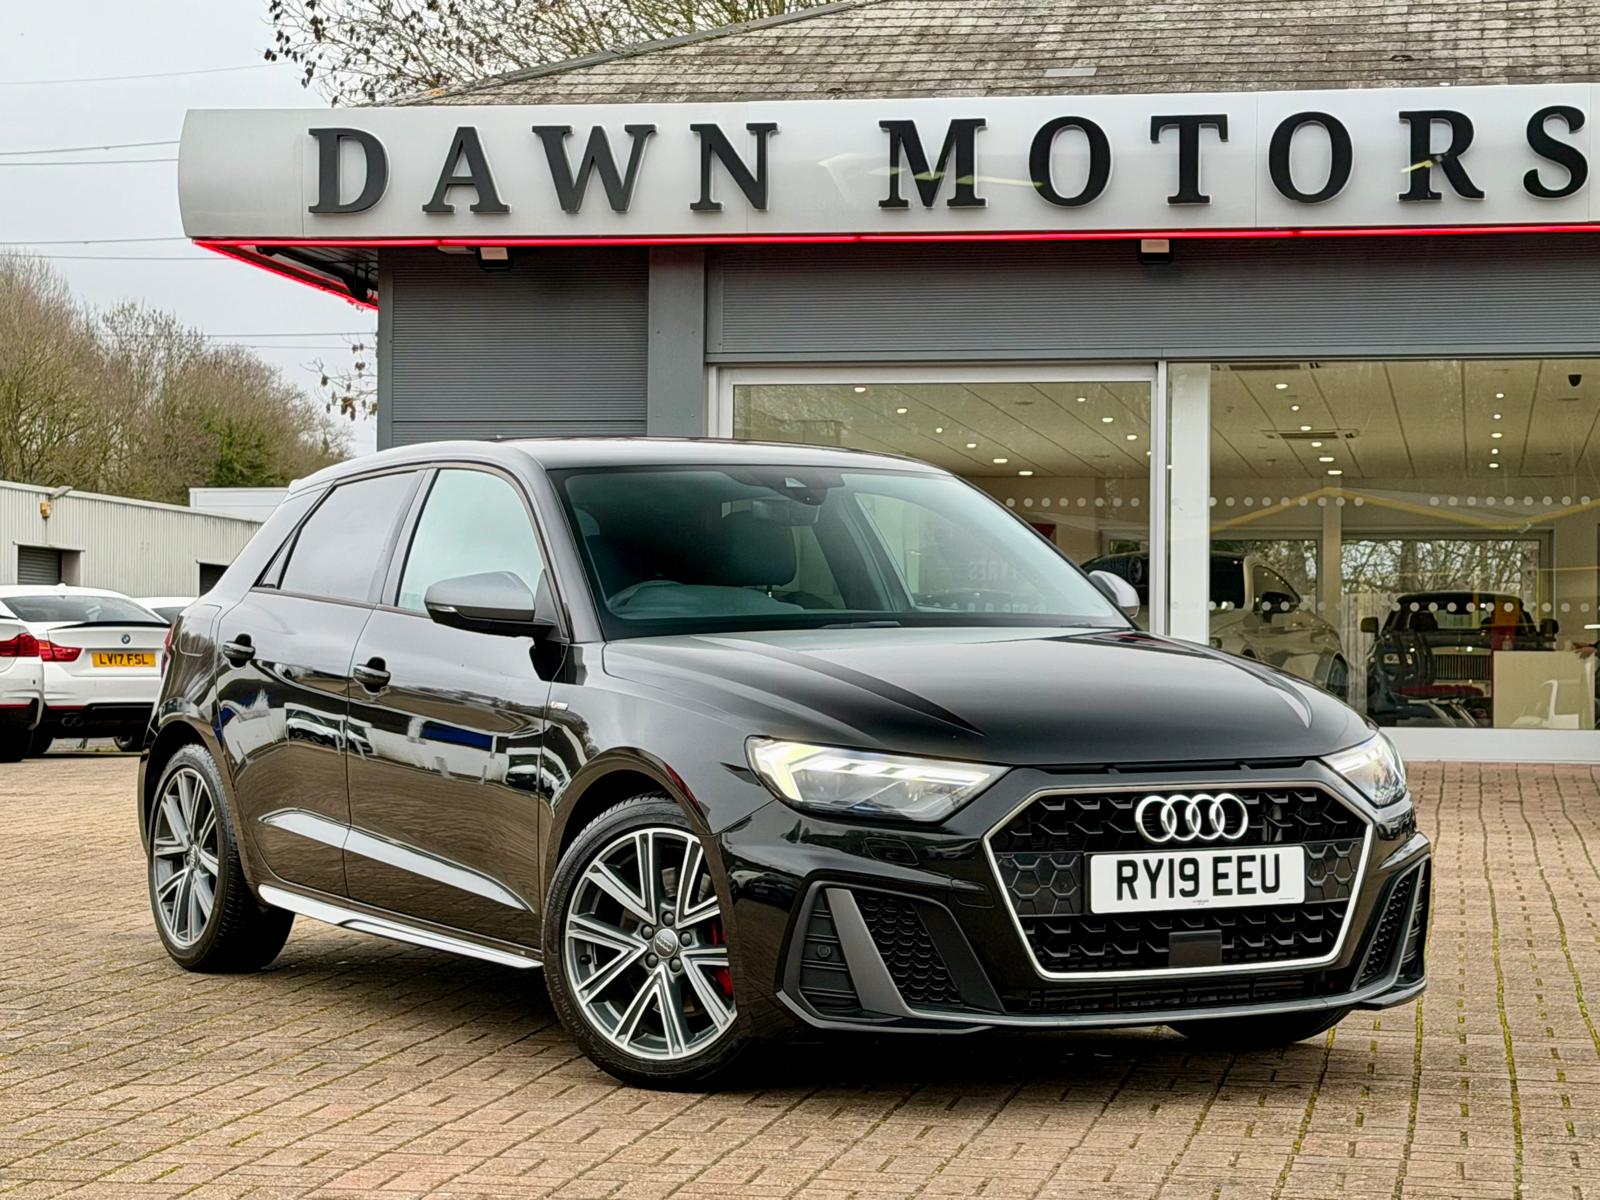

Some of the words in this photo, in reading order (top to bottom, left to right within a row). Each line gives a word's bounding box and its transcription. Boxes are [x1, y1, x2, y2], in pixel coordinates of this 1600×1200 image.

[308, 122, 778, 215] DAWN
[878, 105, 1588, 208] MOTORS
[99, 653, 123, 665] LV17
[127, 653, 149, 665] FSL
[1116, 857, 1200, 901] RY19
[1212, 853, 1280, 897] EEU
